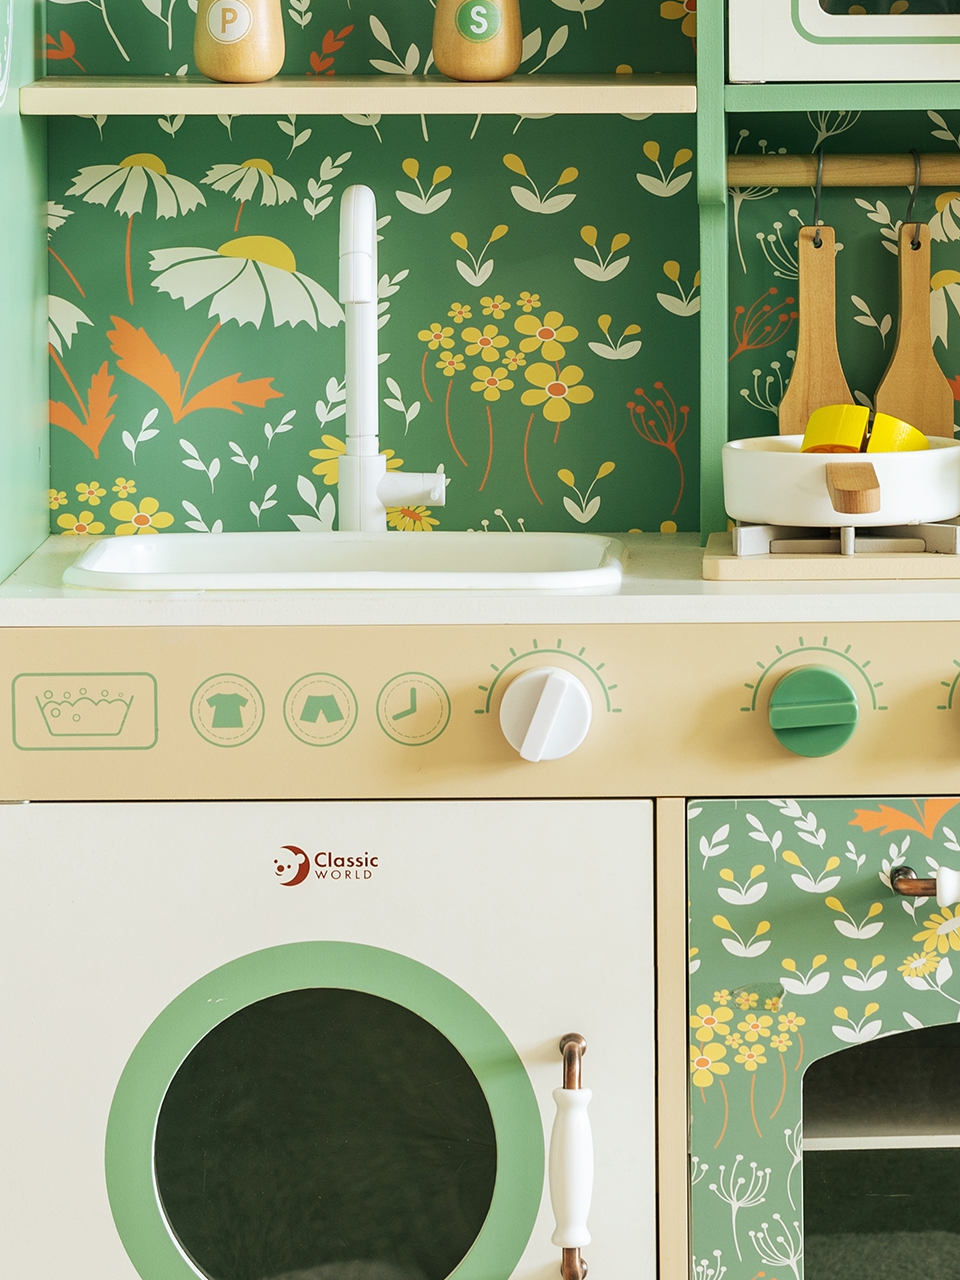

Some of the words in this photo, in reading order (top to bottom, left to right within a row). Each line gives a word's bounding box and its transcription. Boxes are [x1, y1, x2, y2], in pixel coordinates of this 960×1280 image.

[221, 7, 238, 34] P
[470, 5, 488, 35] S
[314, 851, 379, 868] Classic
[314, 869, 372, 880] WORLD
